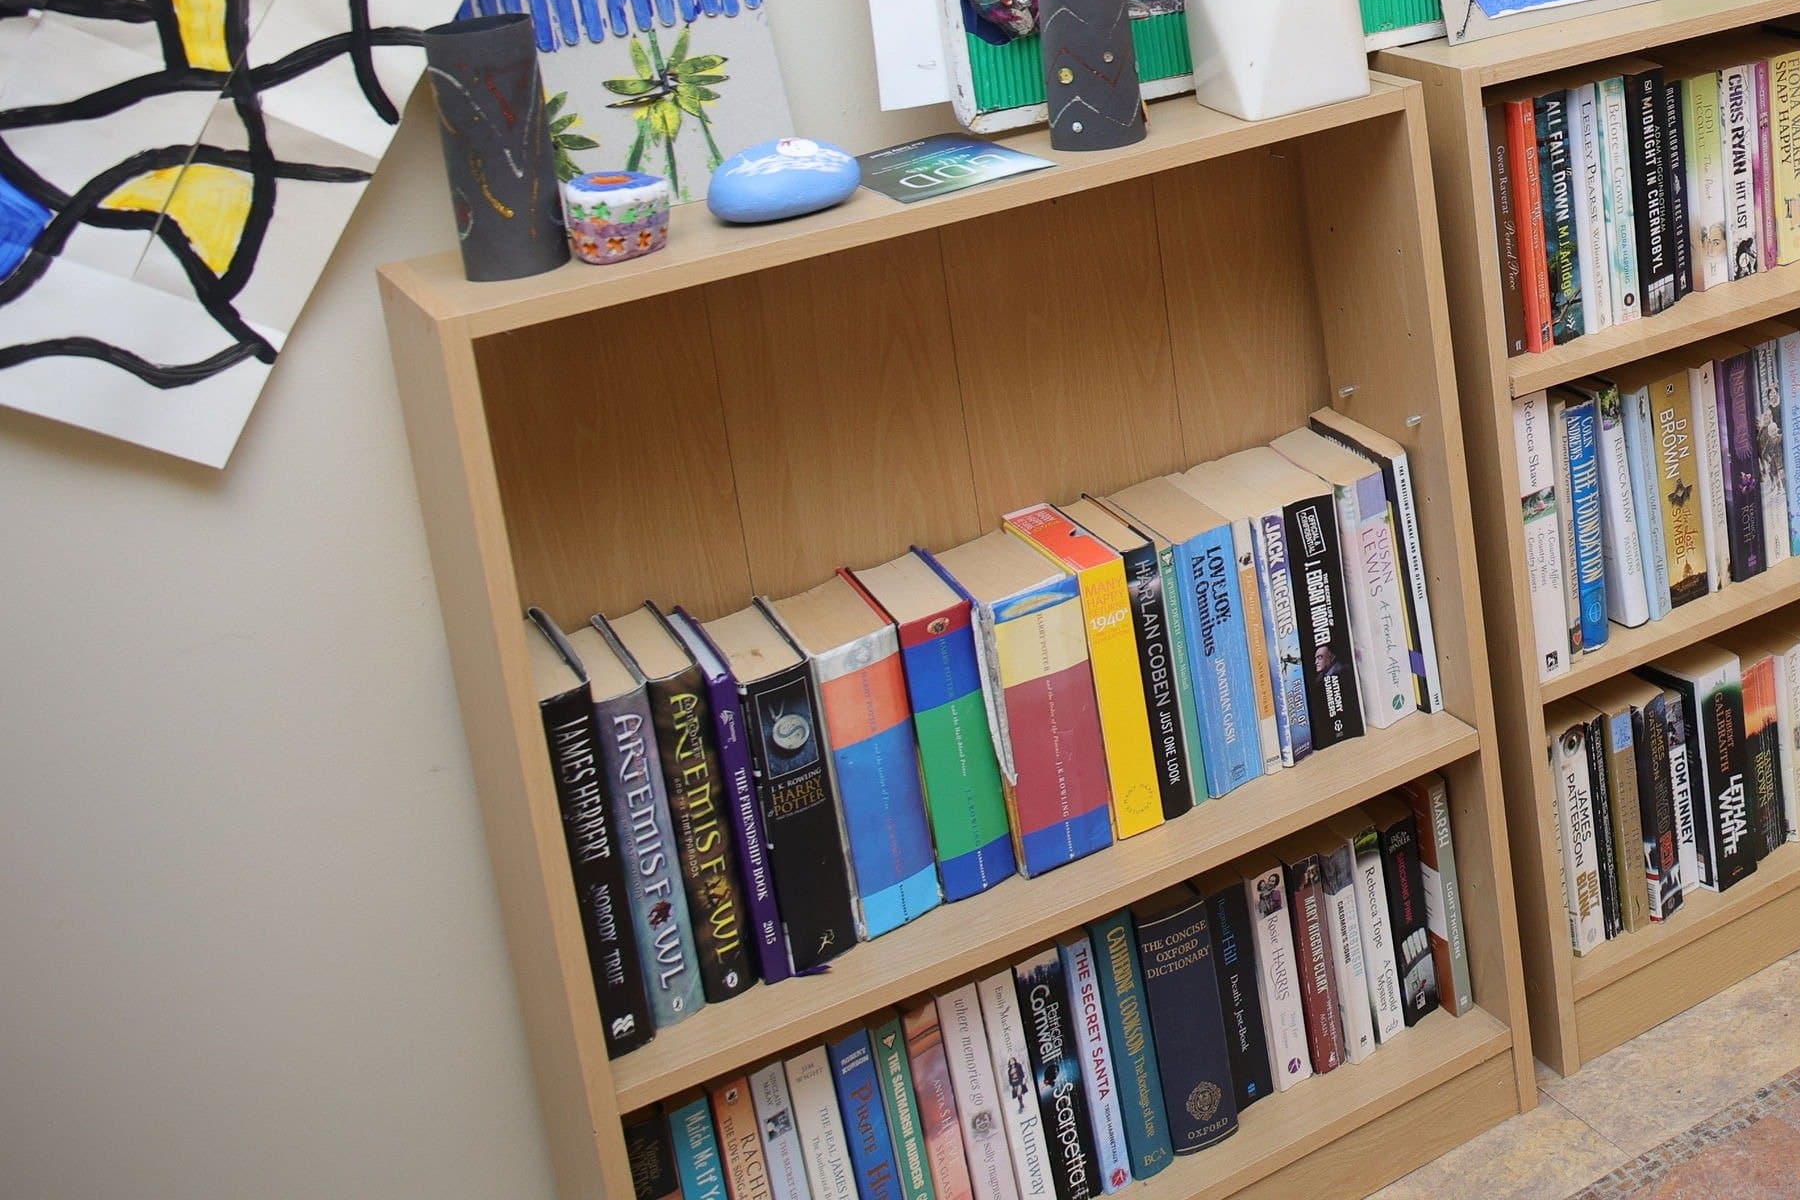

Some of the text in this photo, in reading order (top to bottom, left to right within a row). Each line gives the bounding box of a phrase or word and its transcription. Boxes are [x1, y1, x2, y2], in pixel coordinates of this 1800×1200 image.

[1776, 62, 1788, 101] SNAP
[1705, 103, 1714, 133] JODI
[1728, 73, 1747, 229] CHRIS RYAN HIT LIST
[1777, 103, 1792, 164] HAPPY
[1545, 100, 1570, 223] ALL FALL DOWN
[1582, 100, 1598, 223] LESLEY PEARSE
[1641, 97, 1664, 274] MIDNIGHT IN CHERNOBYL
[1524, 400, 1537, 489] Rebecca Shaw
[1567, 415, 1583, 460] ANDREWS
[1660, 408, 1681, 479] BROWN
[1672, 418, 1690, 458] DAN
[1361, 529, 1383, 597] LEWIS
[1376, 528, 1394, 584] SUSAN
[1671, 508, 1685, 564] SYMBOL
[1191, 555, 1216, 657] An Omnibus
[1266, 520, 1295, 640] JACK HIGGINS
[1305, 570, 1325, 601] EDGAR
[1135, 559, 1171, 707] HARLAN COBEN
[1311, 601, 1330, 647] HOOVER
[1215, 658, 1232, 711] JONATHAN
[1324, 676, 1337, 718] SUMMERS
[1331, 675, 1344, 712] ANTHONY
[553, 715, 596, 788] JAMES
[1159, 710, 1181, 785] JUST ONE LOOK
[1714, 692, 1734, 774] ROBERT GALBRAITH
[613, 713, 665, 875] ARTEMIS
[669, 693, 721, 853] ARTEMIS
[772, 778, 822, 805] HARRY
[773, 788, 825, 817] POTTER
[1672, 752, 1696, 845] TOM FINNEY
[734, 767, 769, 901] THE FRIENDSHIP BOOK
[1432, 790, 1450, 848] MARSH
[1566, 772, 1584, 868] PATTERSON
[1577, 788, 1589, 842] JAMES
[1717, 773, 1747, 858] LETHAL WHITE
[762, 920, 776, 945] 2015
[1365, 864, 1383, 949] Rebecca Tope
[1576, 871, 1590, 923] BLINK
[1106, 926, 1134, 994] CATHERINE
[1141, 923, 1207, 953] THE CONCISE
[1147, 945, 1212, 980] DICTIONARY
[1155, 938, 1200, 963] OXFORD
[1305, 895, 1319, 922] MARY
[1314, 962, 1328, 994] CLARK
[953, 998, 984, 1106] where memories go
[1030, 984, 1055, 1064] Cornwell
[1074, 948, 1111, 1101] THE SECRET SANTA
[887, 1052, 924, 1190] THE SALTMARSH MURDERS
[1020, 1114, 1046, 1195] Runaway
[1187, 1118, 1228, 1140] OXFORD
